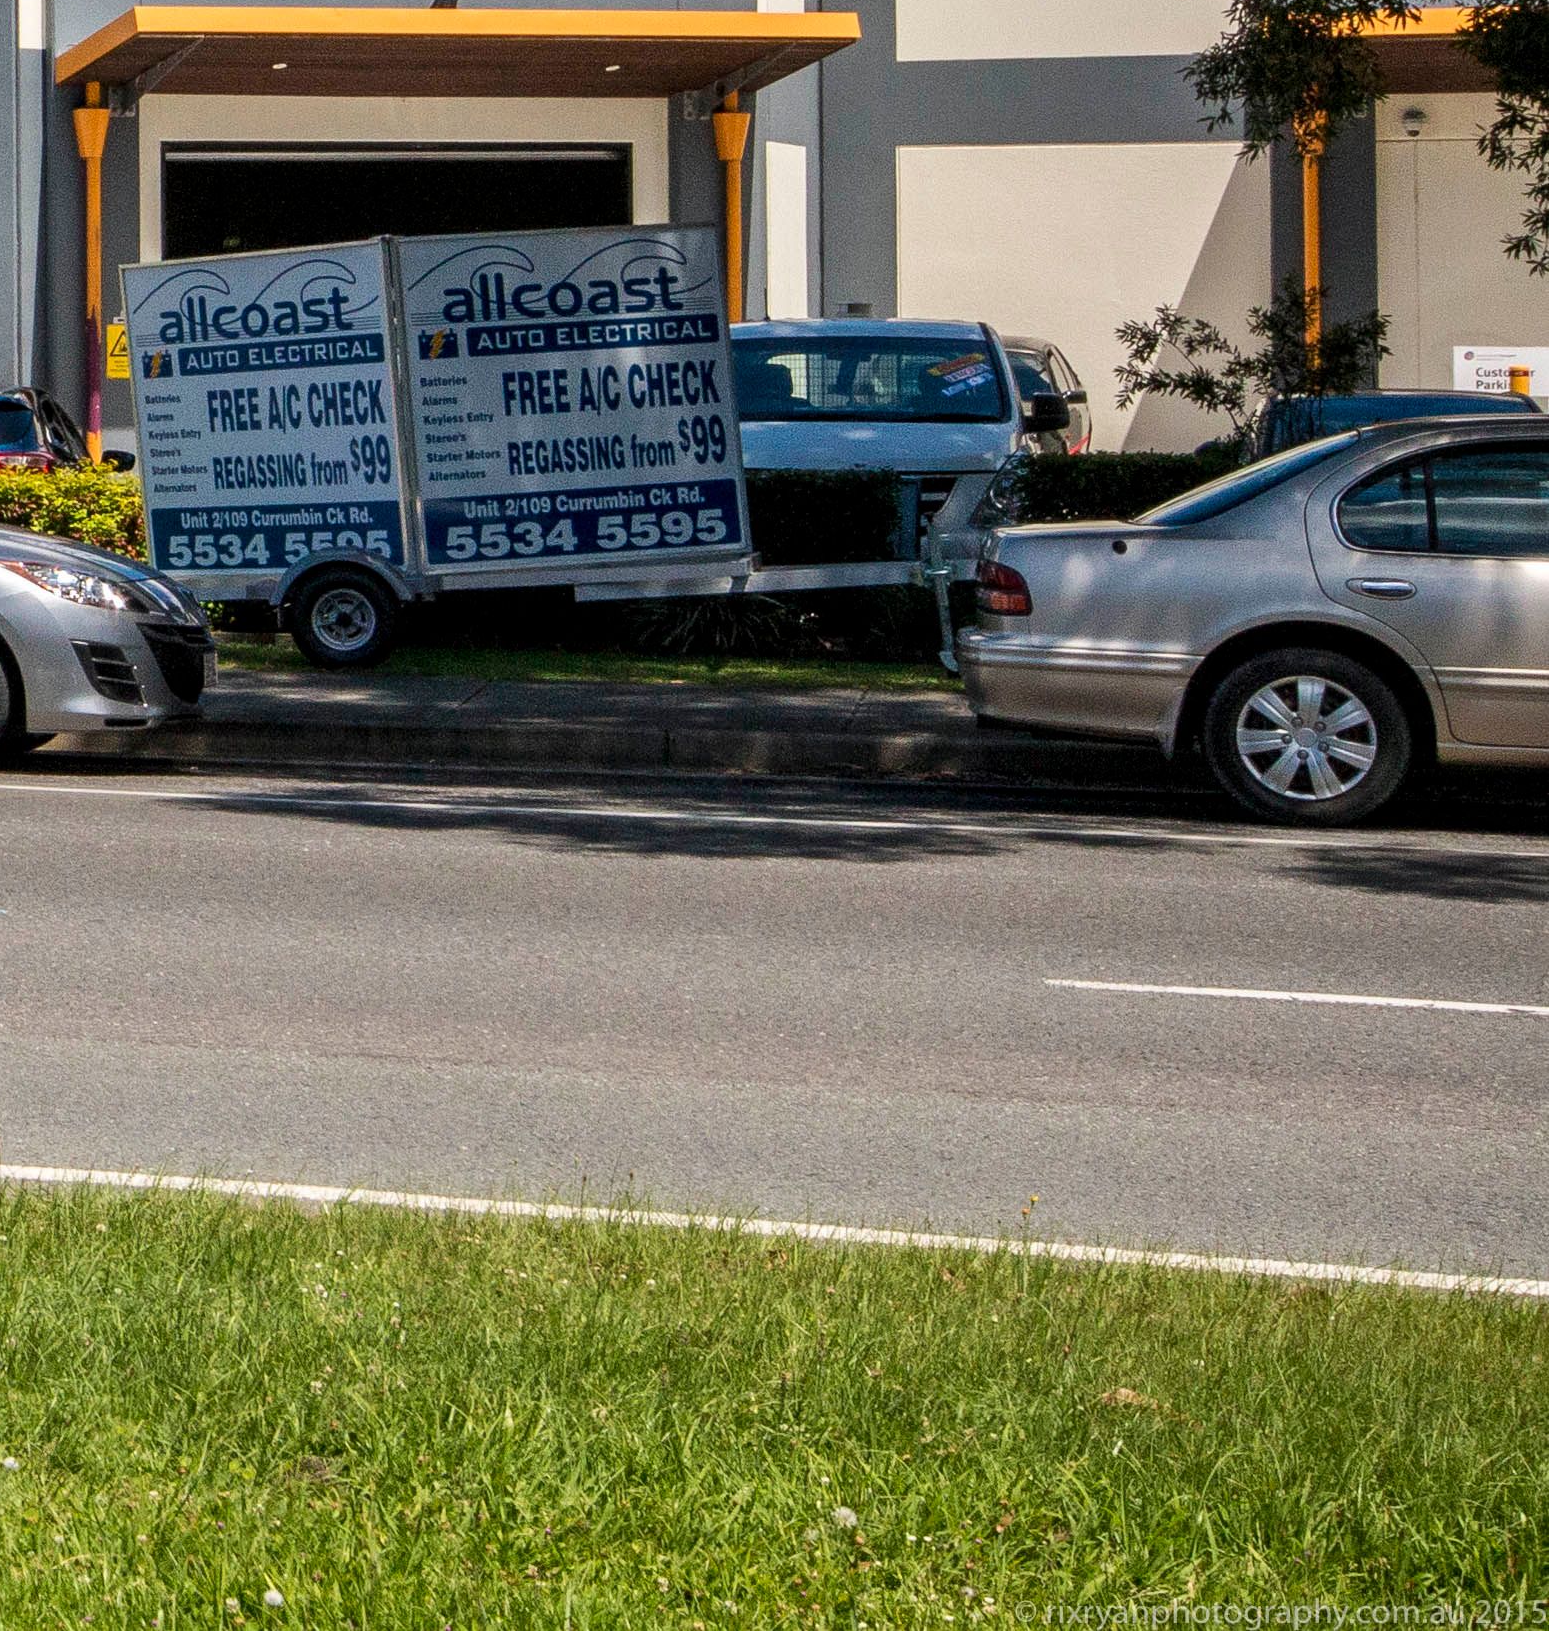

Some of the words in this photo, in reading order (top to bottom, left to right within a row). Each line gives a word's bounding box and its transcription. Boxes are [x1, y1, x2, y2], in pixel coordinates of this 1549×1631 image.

[443, 266, 684, 322] allcoast
[160, 287, 354, 344] allcoast
[477, 329, 545, 350] AUTO
[556, 320, 711, 345] ELECTRICAL
[186, 349, 240, 370] AUTO
[248, 339, 379, 365] ELECTRICAL
[420, 375, 468, 387] Batteries
[502, 368, 571, 417] FREE
[579, 365, 621, 416] A/C
[627, 359, 720, 410] CHECK
[206, 386, 263, 433] FREE
[268, 384, 302, 434] A/C
[307, 378, 387, 426] CHECK
[422, 395, 458, 406] Alarms
[422, 413, 464, 426] Keyless
[467, 411, 494, 424] Entry
[181, 429, 202, 441] Entry
[507, 435, 626, 476] REGASSING
[630, 433, 676, 467] from
[677, 415, 727, 465] $99
[212, 453, 307, 490] REGASSING
[310, 451, 348, 487] from
[349, 434, 392, 485] $99
[426, 452, 463, 464] Starter
[465, 449, 501, 461] Motors
[154, 483, 197, 493] Alternators
[429, 469, 486, 482] Alternators
[463, 500, 500, 519] Unit
[505, 496, 551, 517] 2/109
[556, 490, 645, 513] Currumbin
[649, 488, 672, 506] Ck
[677, 486, 706, 504] Rd.
[181, 511, 209, 530] Unit
[211, 509, 248, 530] 2/109
[251, 507, 323, 528] Currumbin
[326, 508, 345, 524] Ck
[349, 507, 374, 524] Rd.
[445, 519, 578, 559] 5534
[596, 508, 727, 550] 5595
[168, 533, 270, 568] 5534
